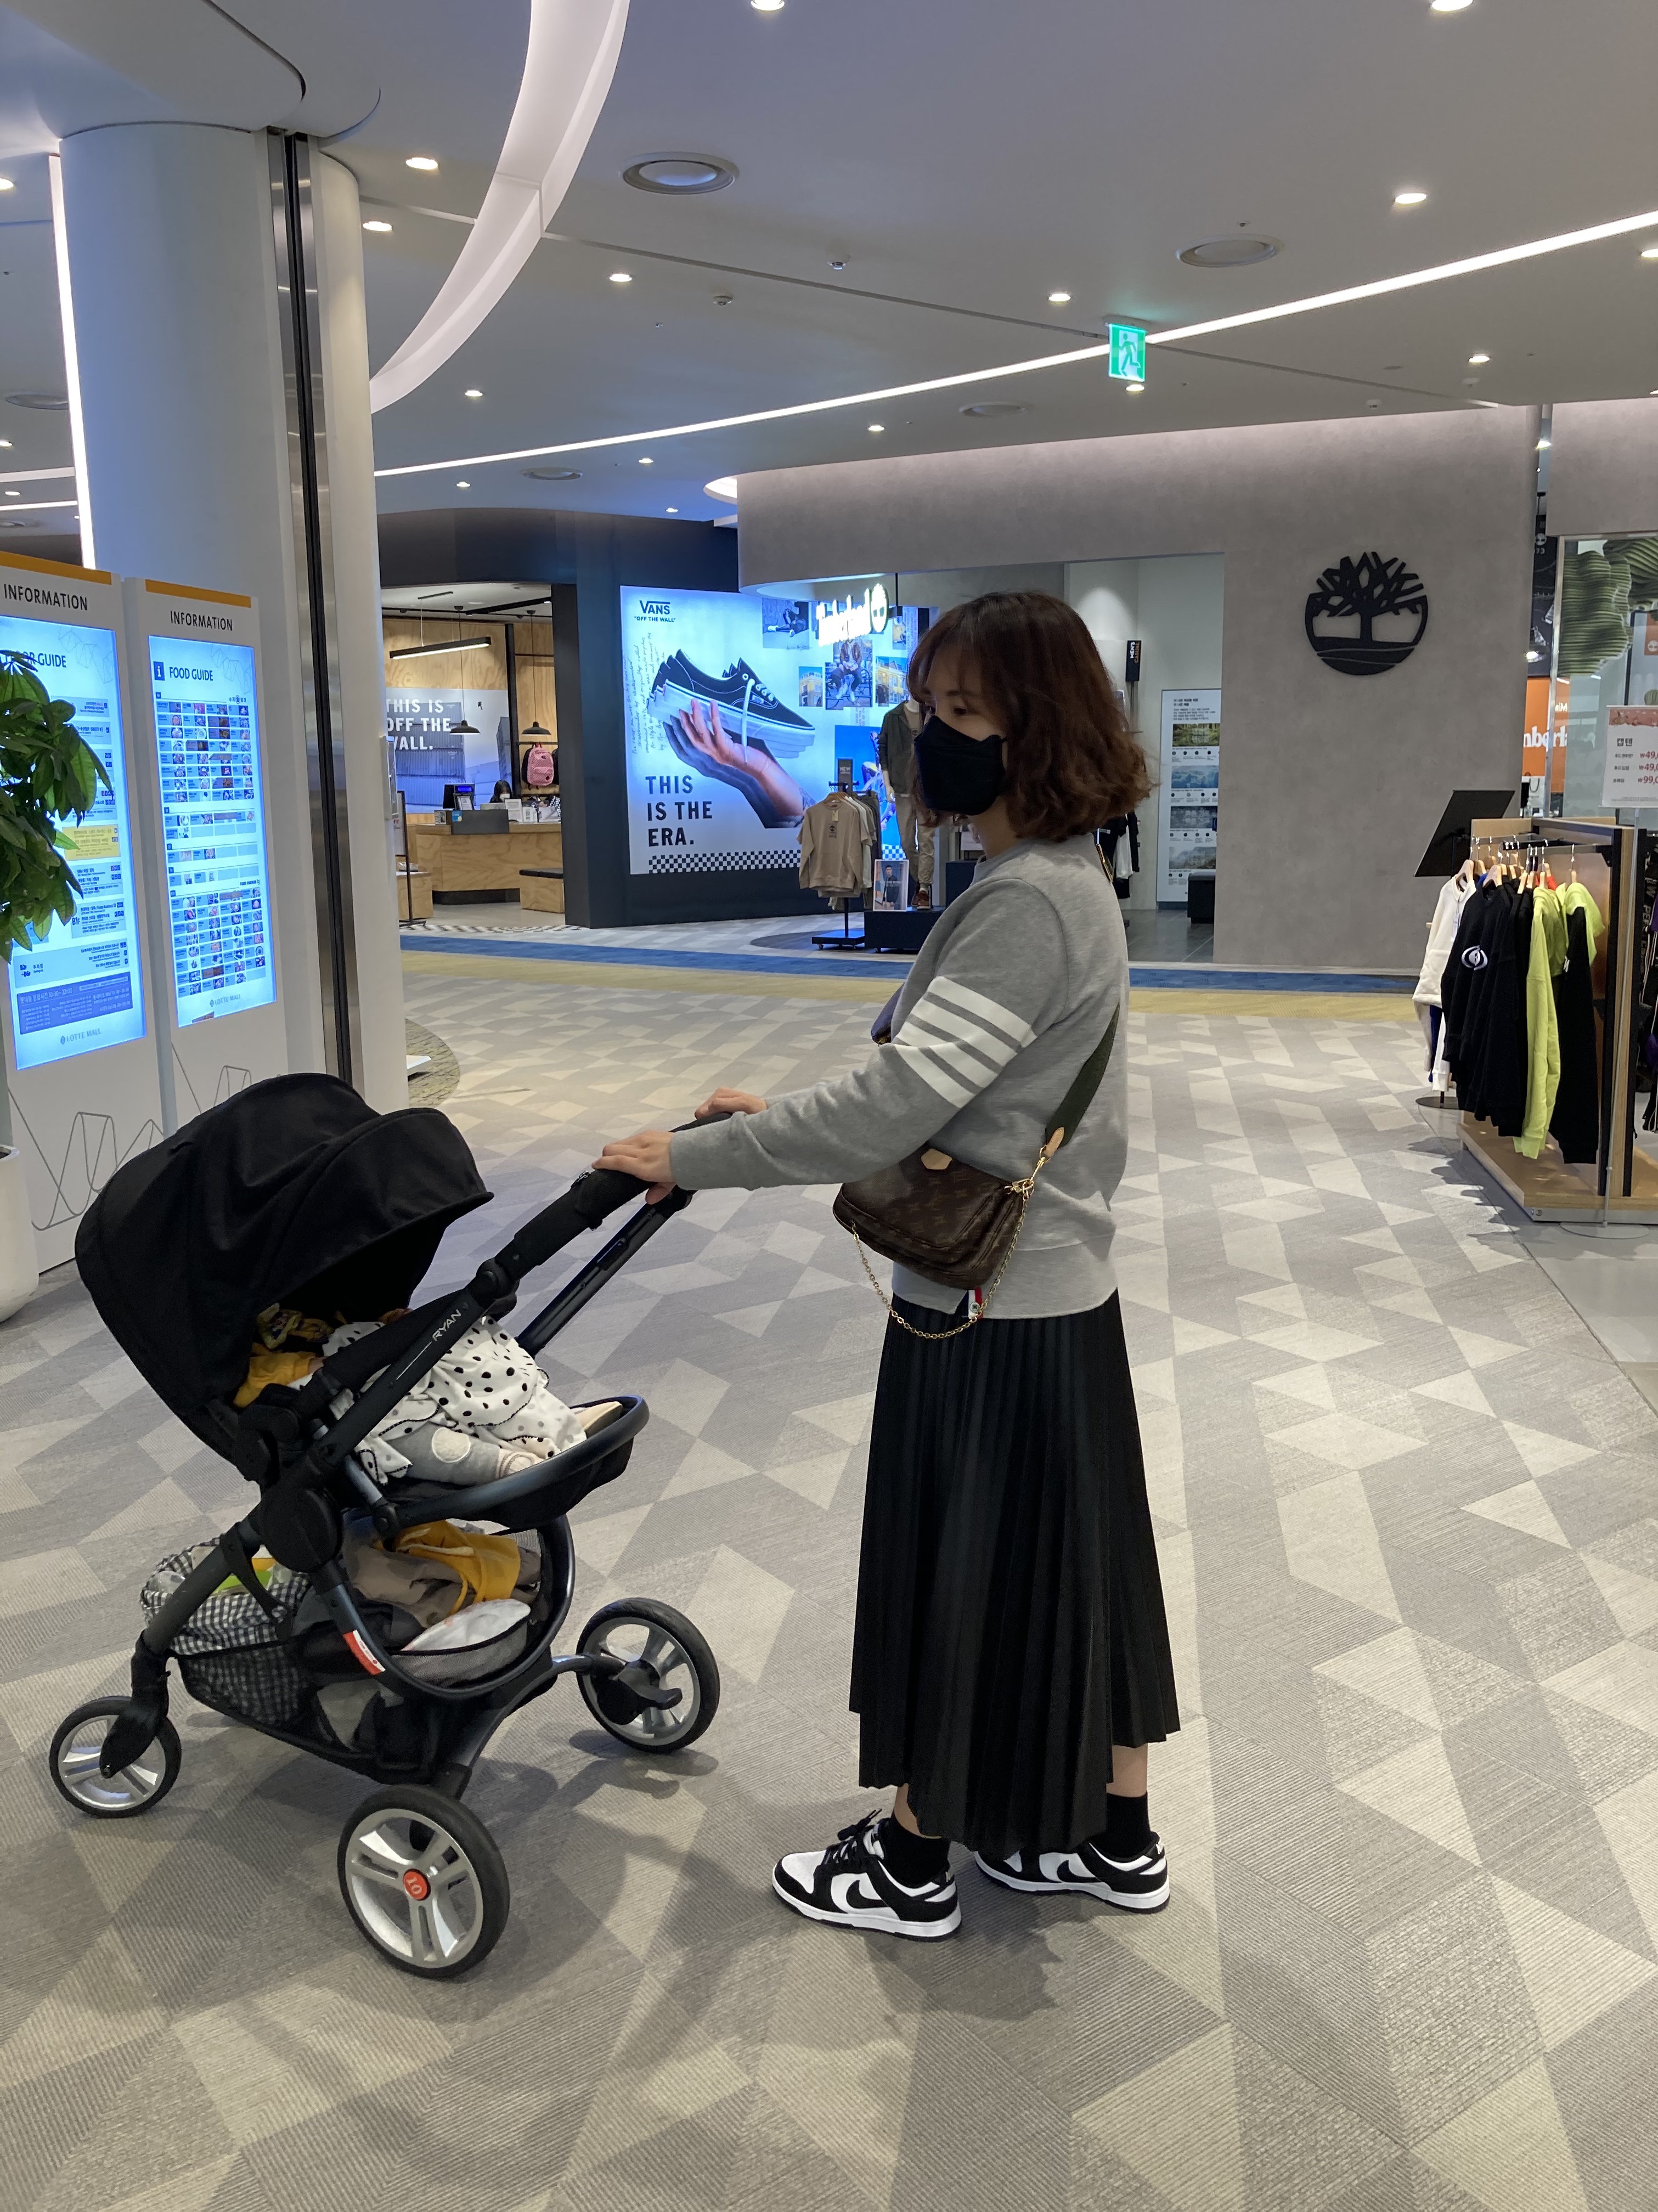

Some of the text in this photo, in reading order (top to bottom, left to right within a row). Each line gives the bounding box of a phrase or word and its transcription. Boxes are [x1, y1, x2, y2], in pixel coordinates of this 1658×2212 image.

[4, 584, 88, 611] INFORMATION
[640, 600, 670, 614] VANS
[170, 611, 233, 631] INFORMATION
[38, 653, 67, 668] GUIDE
[169, 667, 213, 681] FOOD GUIDE
[386, 699, 444, 713] THIS IS
[387, 718, 451, 731] OFF THE
[646, 775, 693, 794] THIS
[647, 801, 713, 821] IS THE
[648, 828, 695, 847] ERA.
[66, 1028, 102, 1042] LOTTE MALL
[432, 1310, 461, 1342] RYAN
